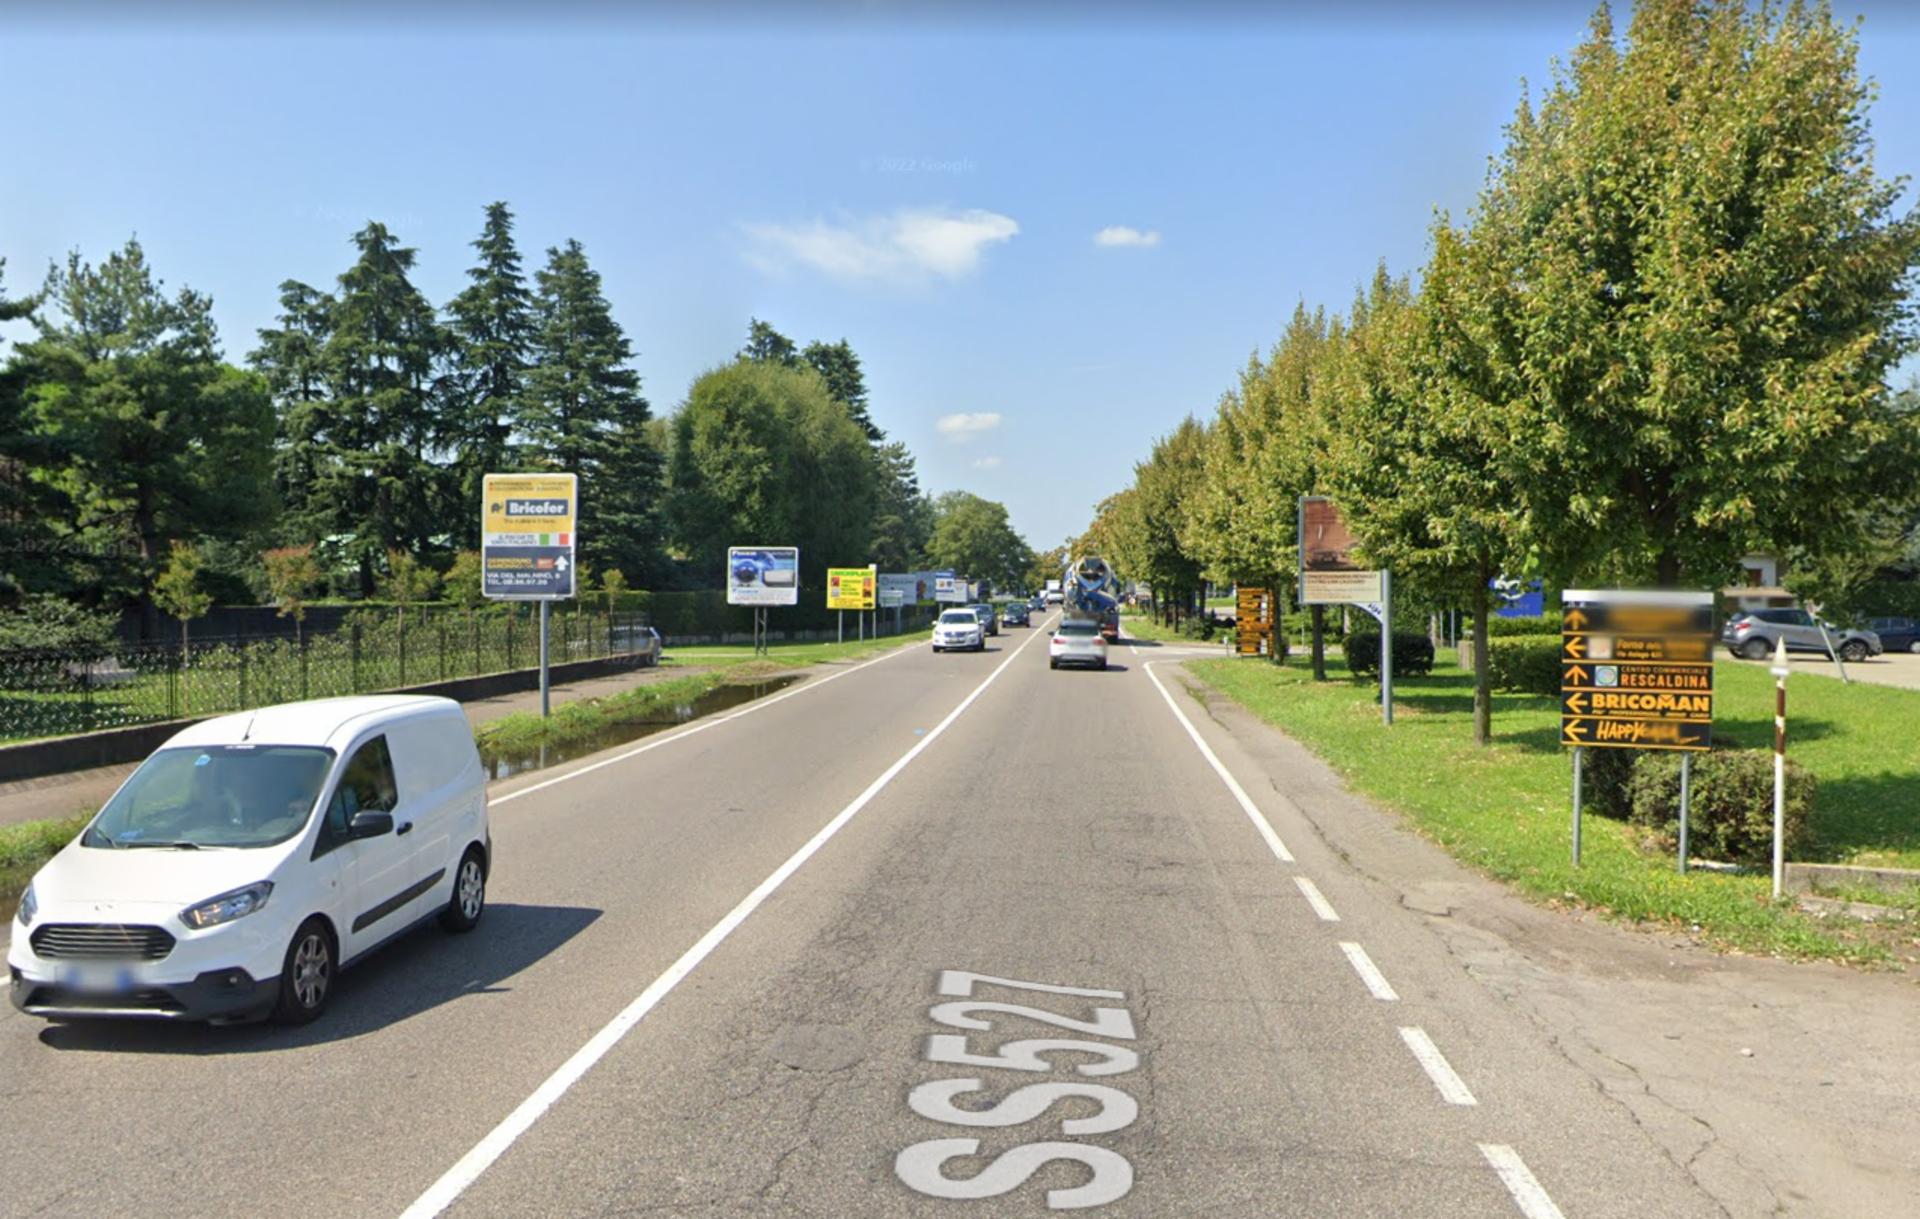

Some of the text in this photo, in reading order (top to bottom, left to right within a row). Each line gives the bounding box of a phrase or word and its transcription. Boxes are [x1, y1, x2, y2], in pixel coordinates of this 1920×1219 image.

[509, 502, 564, 514] Bricofer
[1620, 674, 1708, 688] RESCALDINA
[1593, 693, 1709, 711] BRICOMAN
[895, 970, 1138, 1208] SS527
